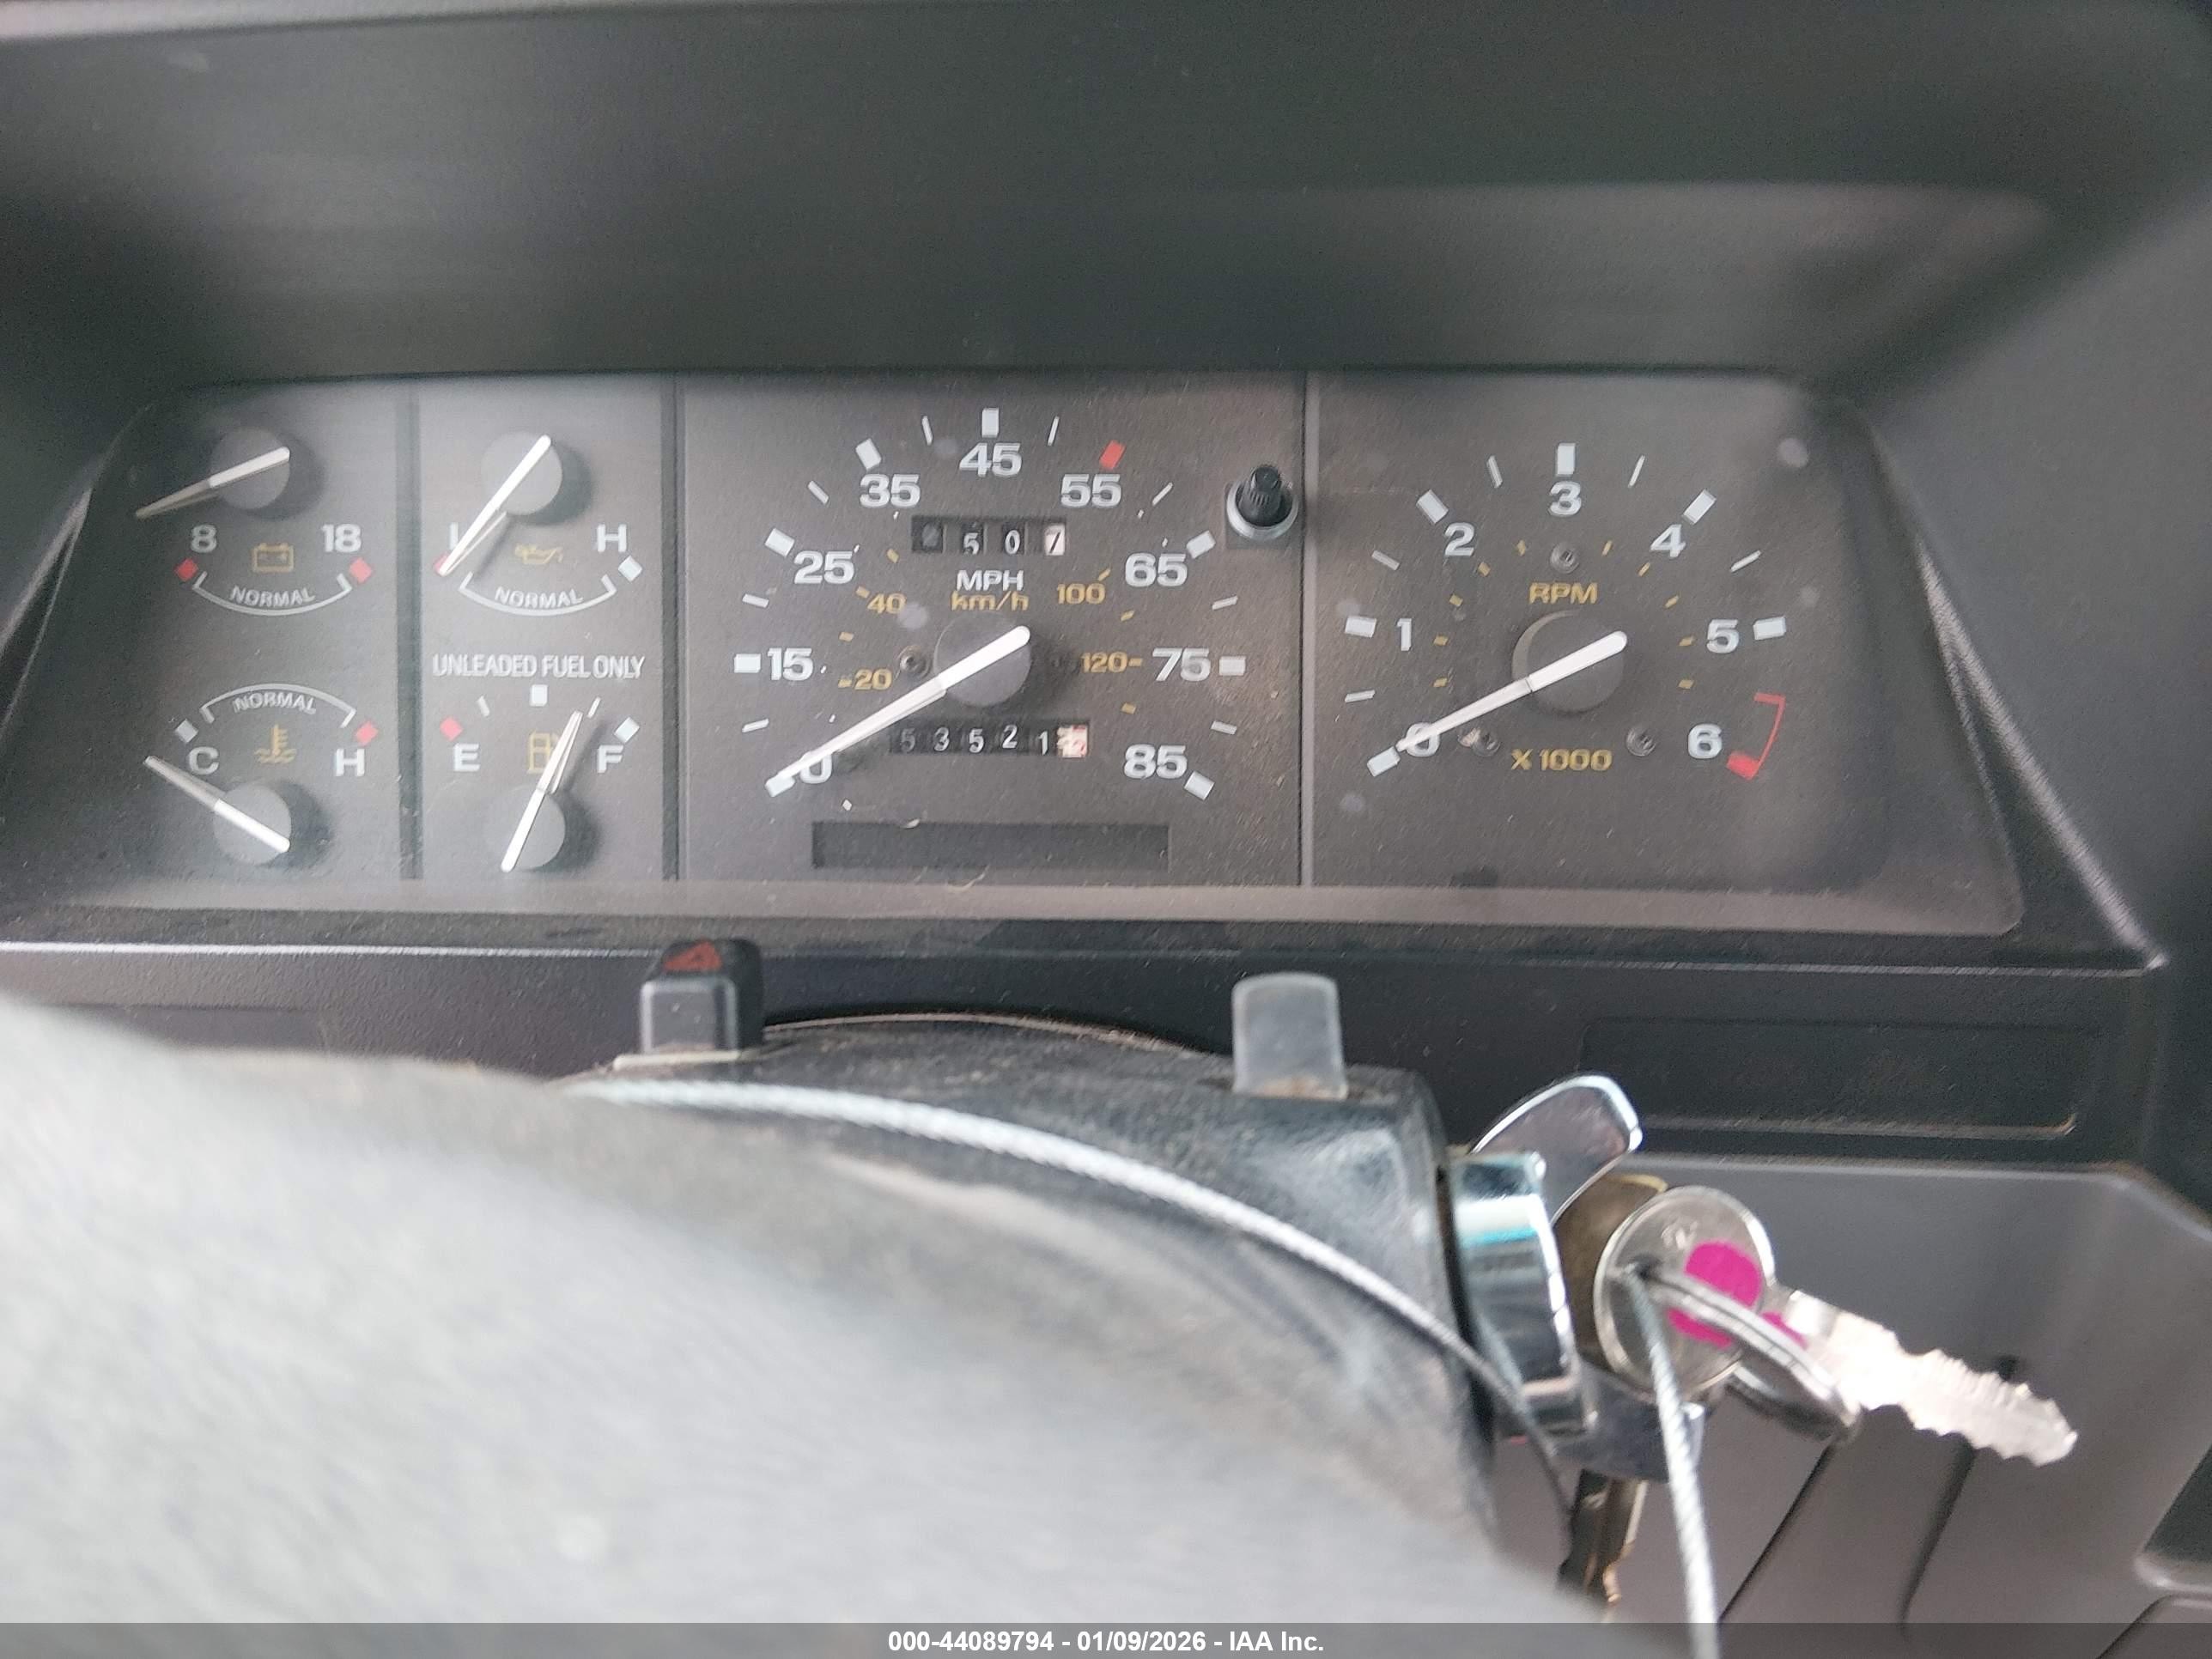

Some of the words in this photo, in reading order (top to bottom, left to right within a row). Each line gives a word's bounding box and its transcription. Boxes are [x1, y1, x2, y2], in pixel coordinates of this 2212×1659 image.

[959, 442, 1022, 477] 45
[859, 475, 921, 508] 35
[1060, 474, 1122, 508] 55
[1548, 481, 1583, 516] 3
[191, 525, 217, 552] 8
[321, 524, 362, 552] 18
[596, 525, 628, 552] H
[1443, 522, 1476, 557] 2
[1650, 524, 1686, 559] 4
[794, 550, 855, 584] 25
[956, 569, 1025, 592] MPH
[1124, 553, 1189, 587] 65
[230, 586, 316, 608] NORMAL
[494, 586, 585, 610] NORMAL
[866, 592, 908, 615] 40
[951, 590, 1030, 611] km/h
[1057, 583, 1106, 605] 100
[1528, 582, 1599, 605] RPM
[1396, 617, 1413, 652] 1
[1705, 618, 1740, 653] 5
[432, 653, 538, 678] UNLEADED
[542, 654, 591, 678] FUEL
[592, 654, 646, 679] ONLY
[767, 648, 813, 682] 15
[1080, 652, 1128, 673] 120
[1152, 647, 1212, 682] 75
[854, 669, 892, 690] 20
[233, 690, 318, 715] NORMAL
[1406, 721, 1441, 757] 0
[1687, 723, 1723, 759] 6
[188, 746, 220, 775] C
[336, 748, 367, 777] H
[453, 743, 481, 772] E
[597, 744, 625, 773] F
[1123, 744, 1189, 780] 85
[1538, 748, 1613, 772] 1000
